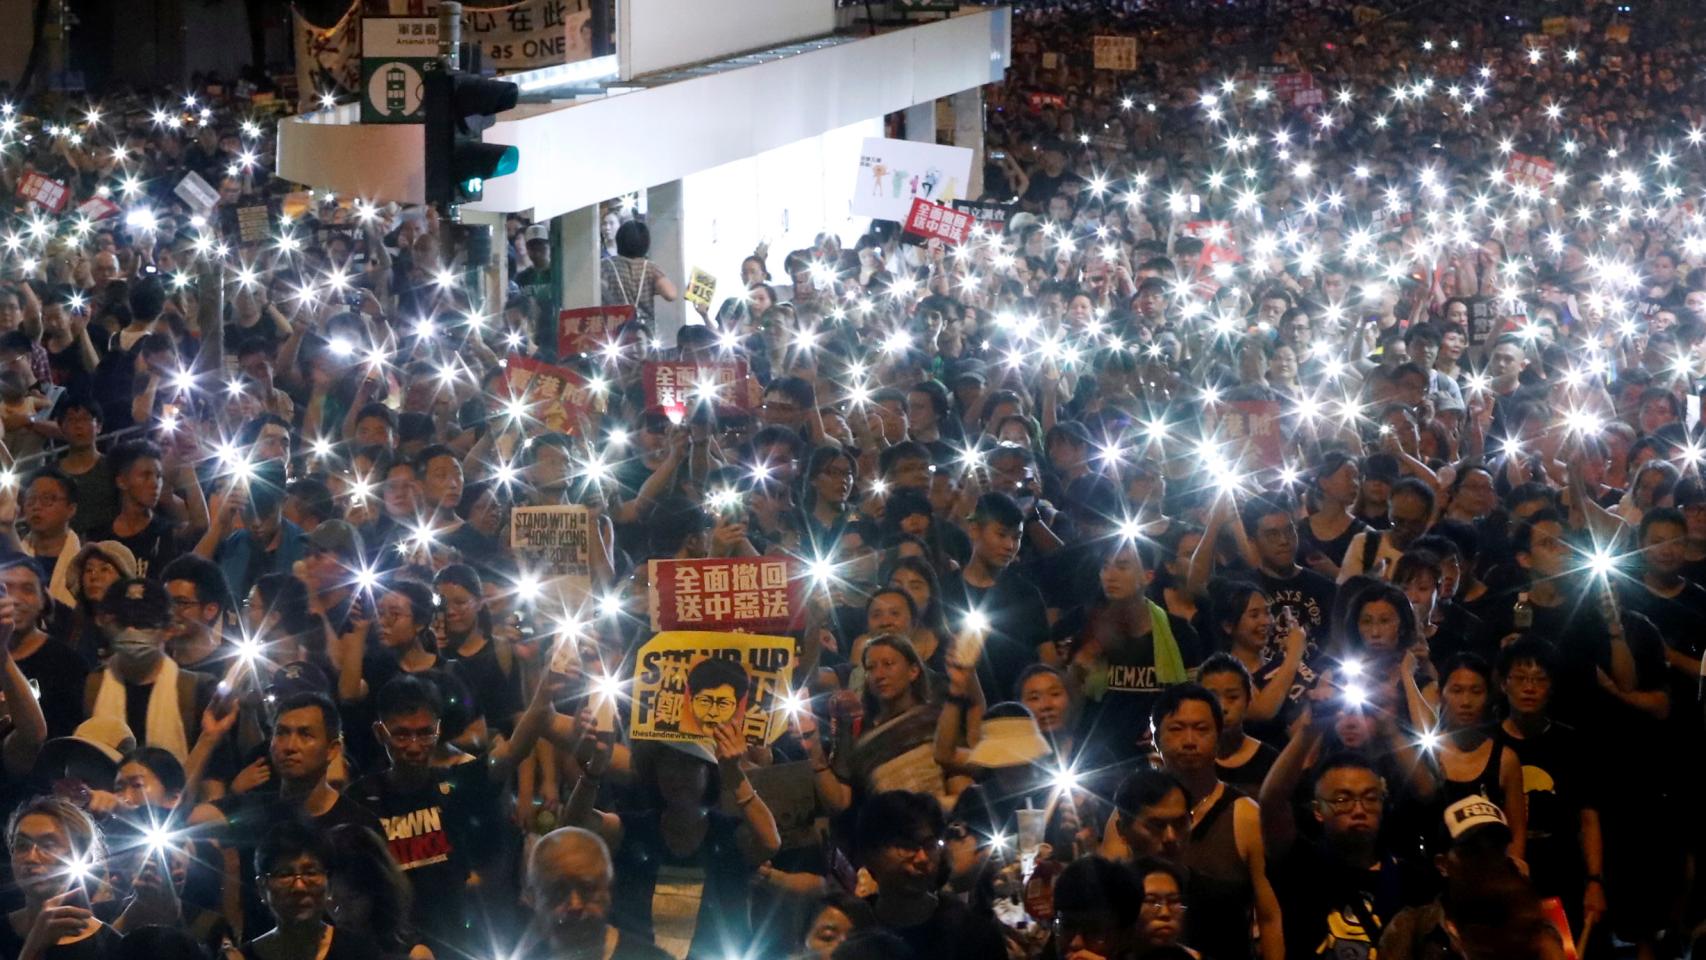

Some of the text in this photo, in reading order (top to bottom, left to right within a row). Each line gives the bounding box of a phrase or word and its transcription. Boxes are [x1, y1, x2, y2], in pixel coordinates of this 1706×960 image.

[491, 36, 566, 60] as ONE
[914, 203, 968, 229] 全面撤回
[655, 366, 736, 389] 全面回
[515, 513, 577, 529] STAND WITH
[528, 530, 587, 546] HONG KONG
[674, 562, 788, 595] 全面撤回
[675, 591, 790, 623] 送中惡法
[748, 648, 789, 673] UP
[632, 730, 705, 741] thestandnews.com
